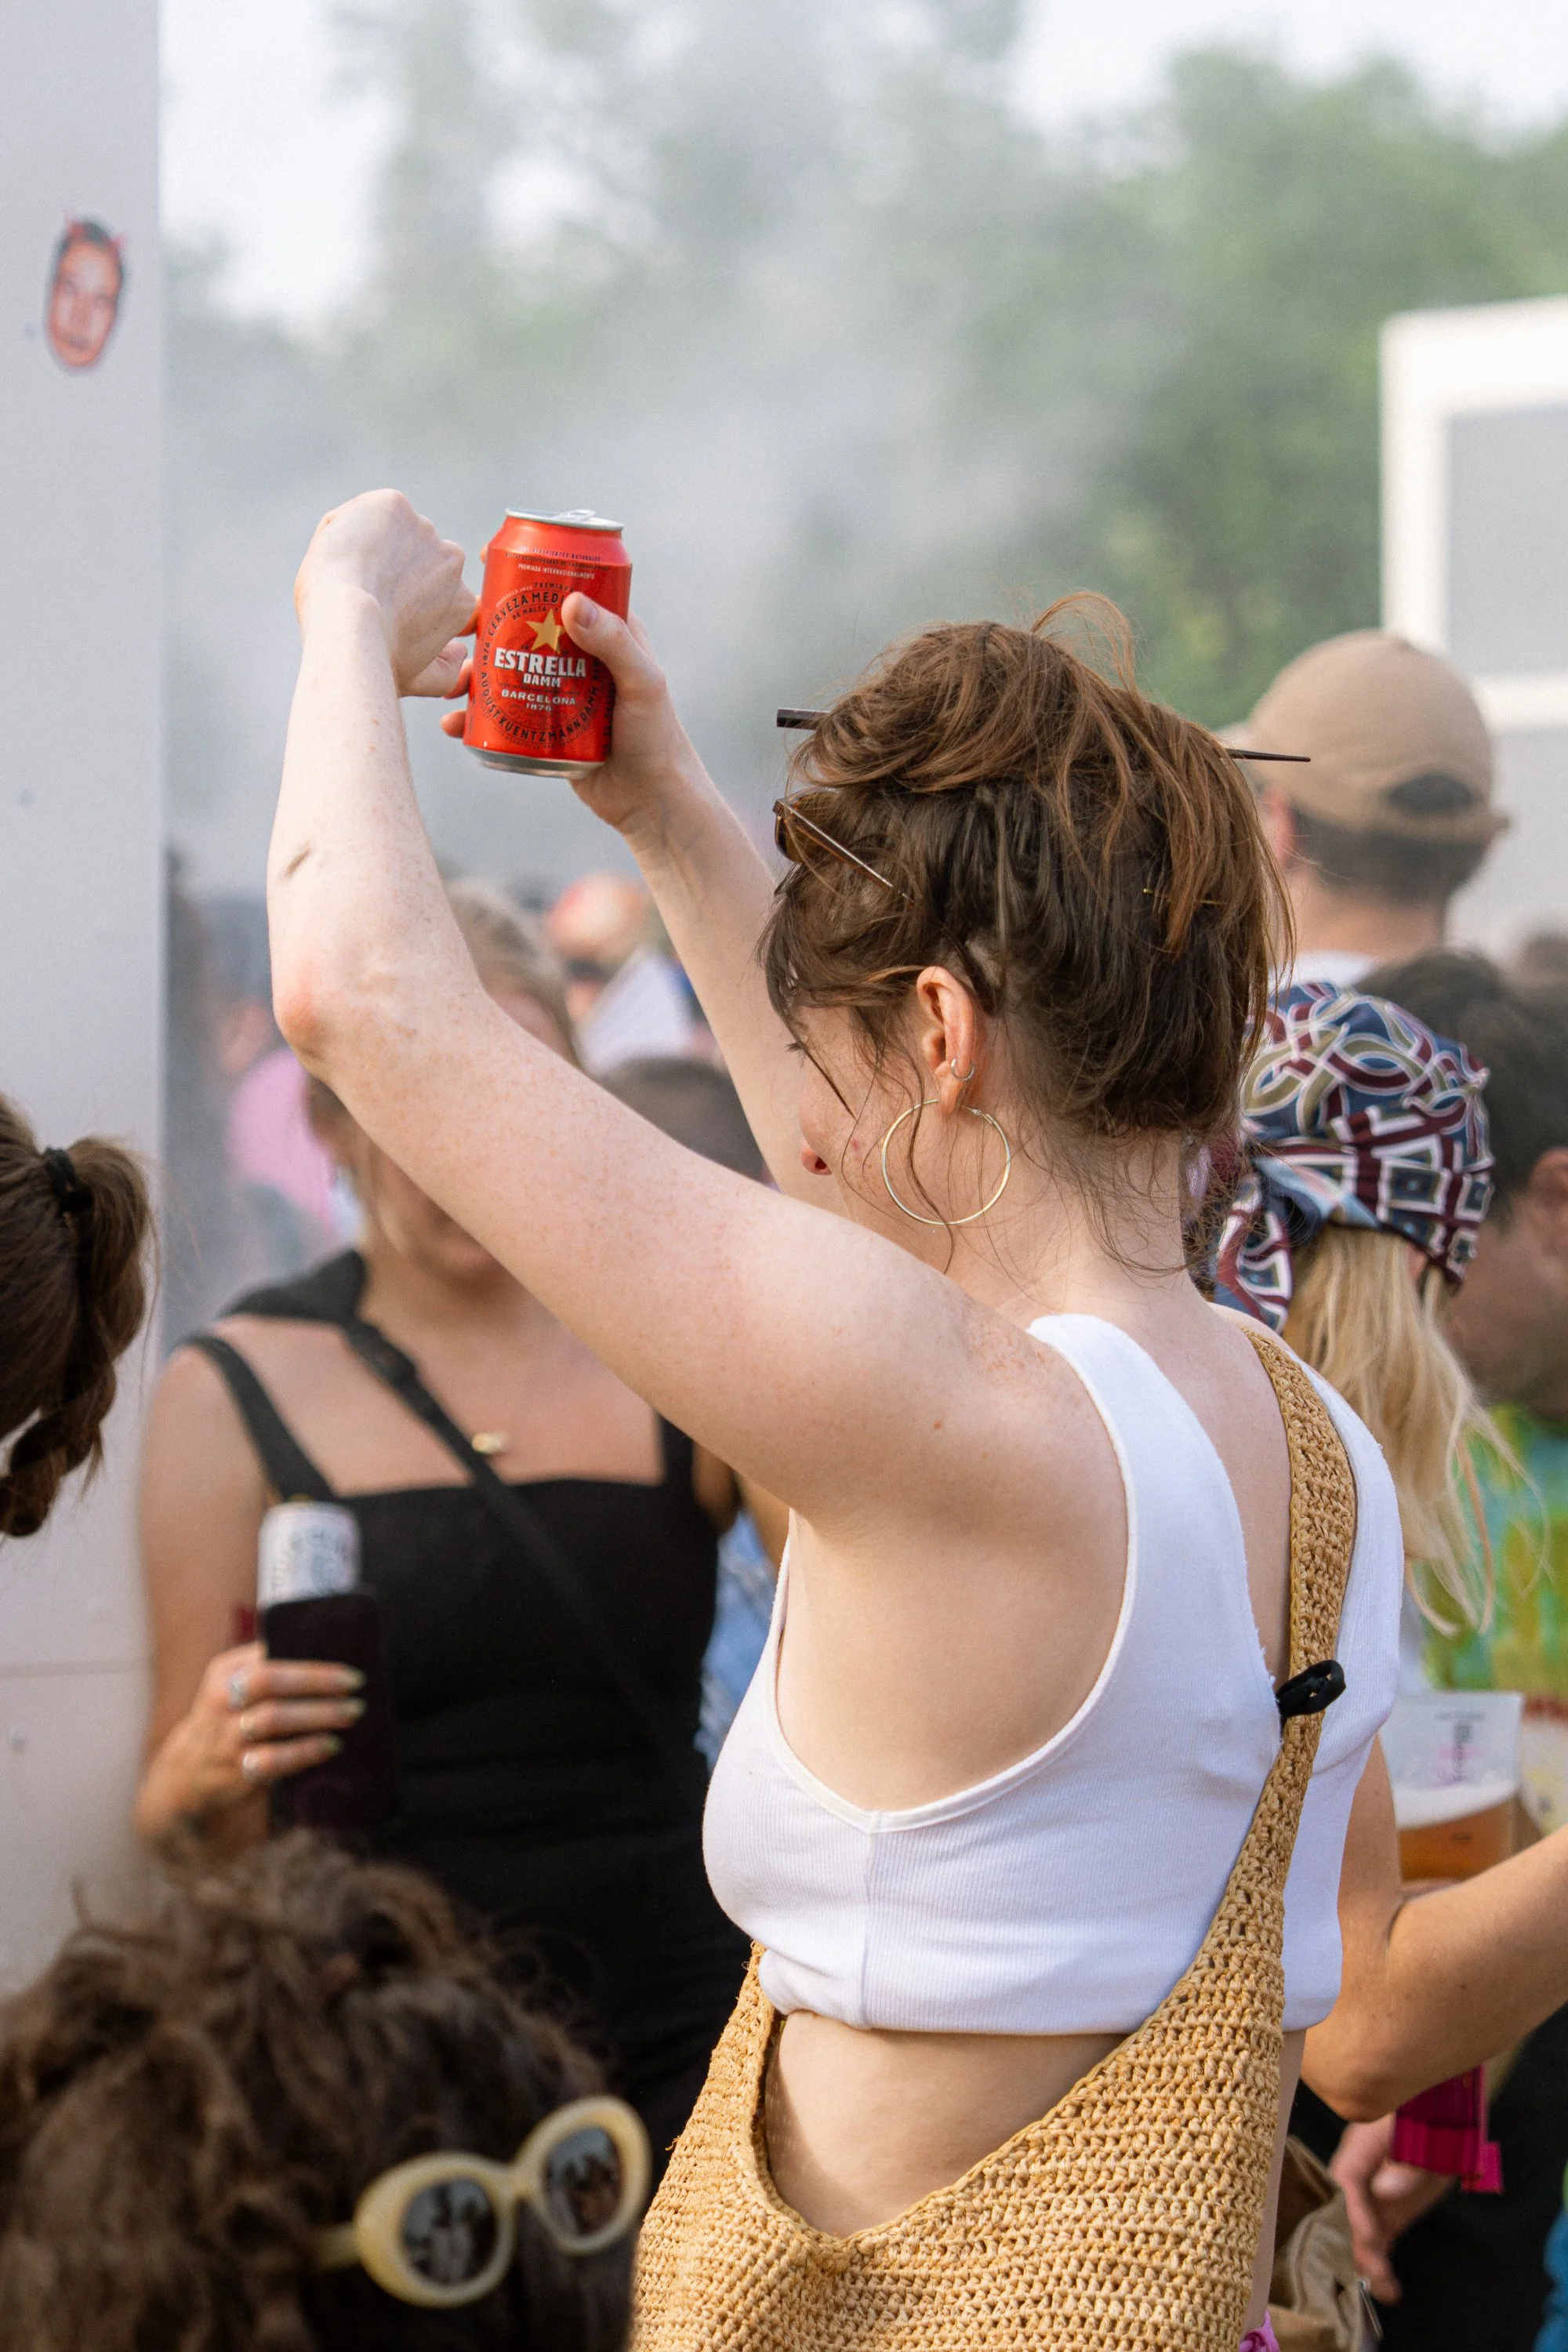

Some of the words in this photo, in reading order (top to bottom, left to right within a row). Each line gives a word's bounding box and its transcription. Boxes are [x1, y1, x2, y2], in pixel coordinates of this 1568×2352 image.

[488, 594, 529, 637] CERVEZA
[532, 592, 564, 605] MEDI
[494, 647, 586, 678] ESTRELLA
[523, 673, 561, 688] DAMM
[481, 671, 501, 719] AUGUST
[499, 716, 581, 742] KUENTZMANN
[501, 688, 576, 705] BARCELONA
[526, 702, 553, 713] 1876
